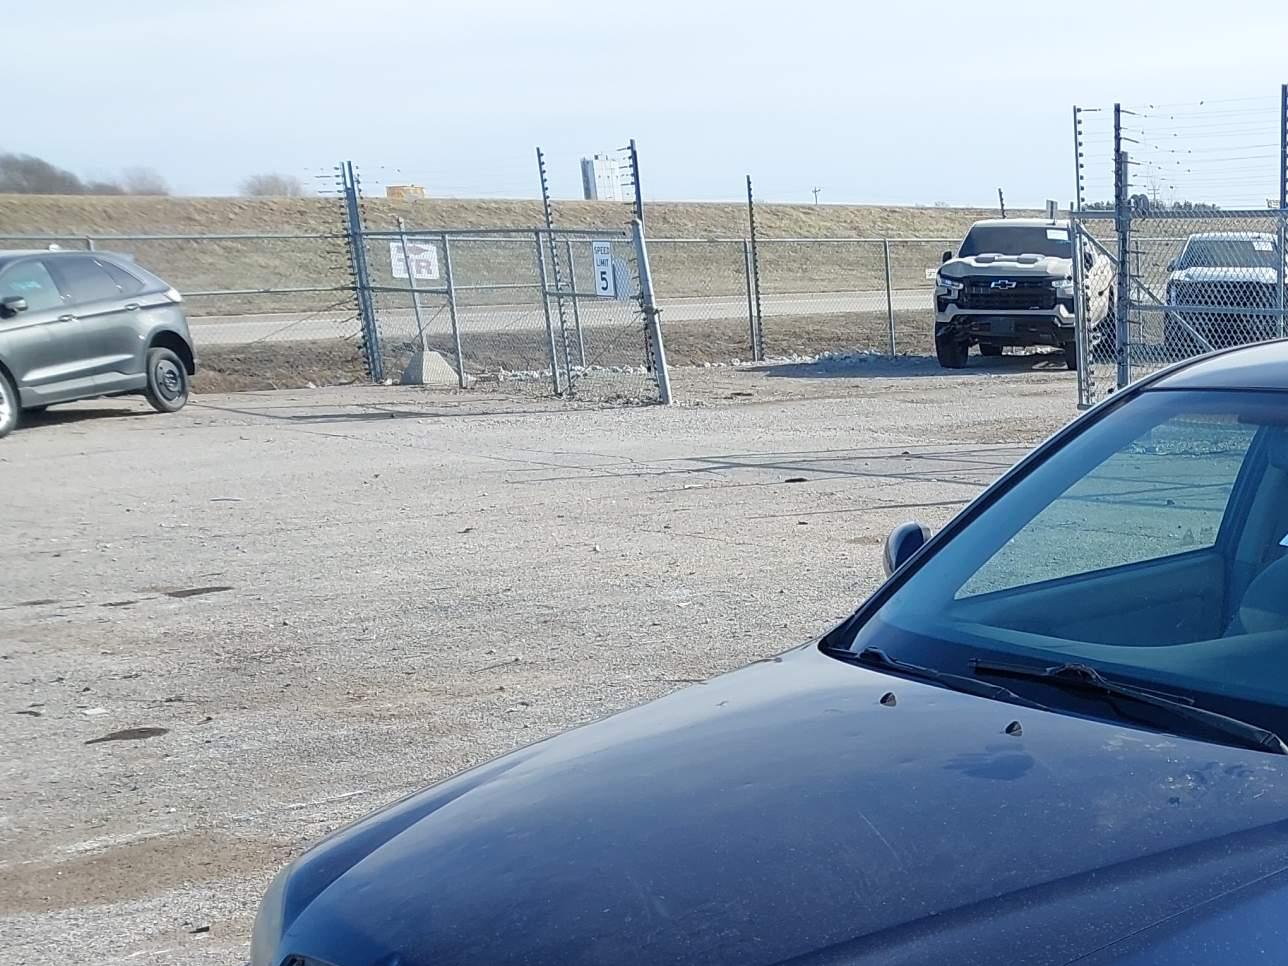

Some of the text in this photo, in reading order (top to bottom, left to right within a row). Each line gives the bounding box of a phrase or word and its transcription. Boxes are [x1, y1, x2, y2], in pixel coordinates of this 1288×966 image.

[594, 245, 610, 255] SPEED
[596, 258, 609, 267] LIMIT
[599, 270, 609, 291] 5
